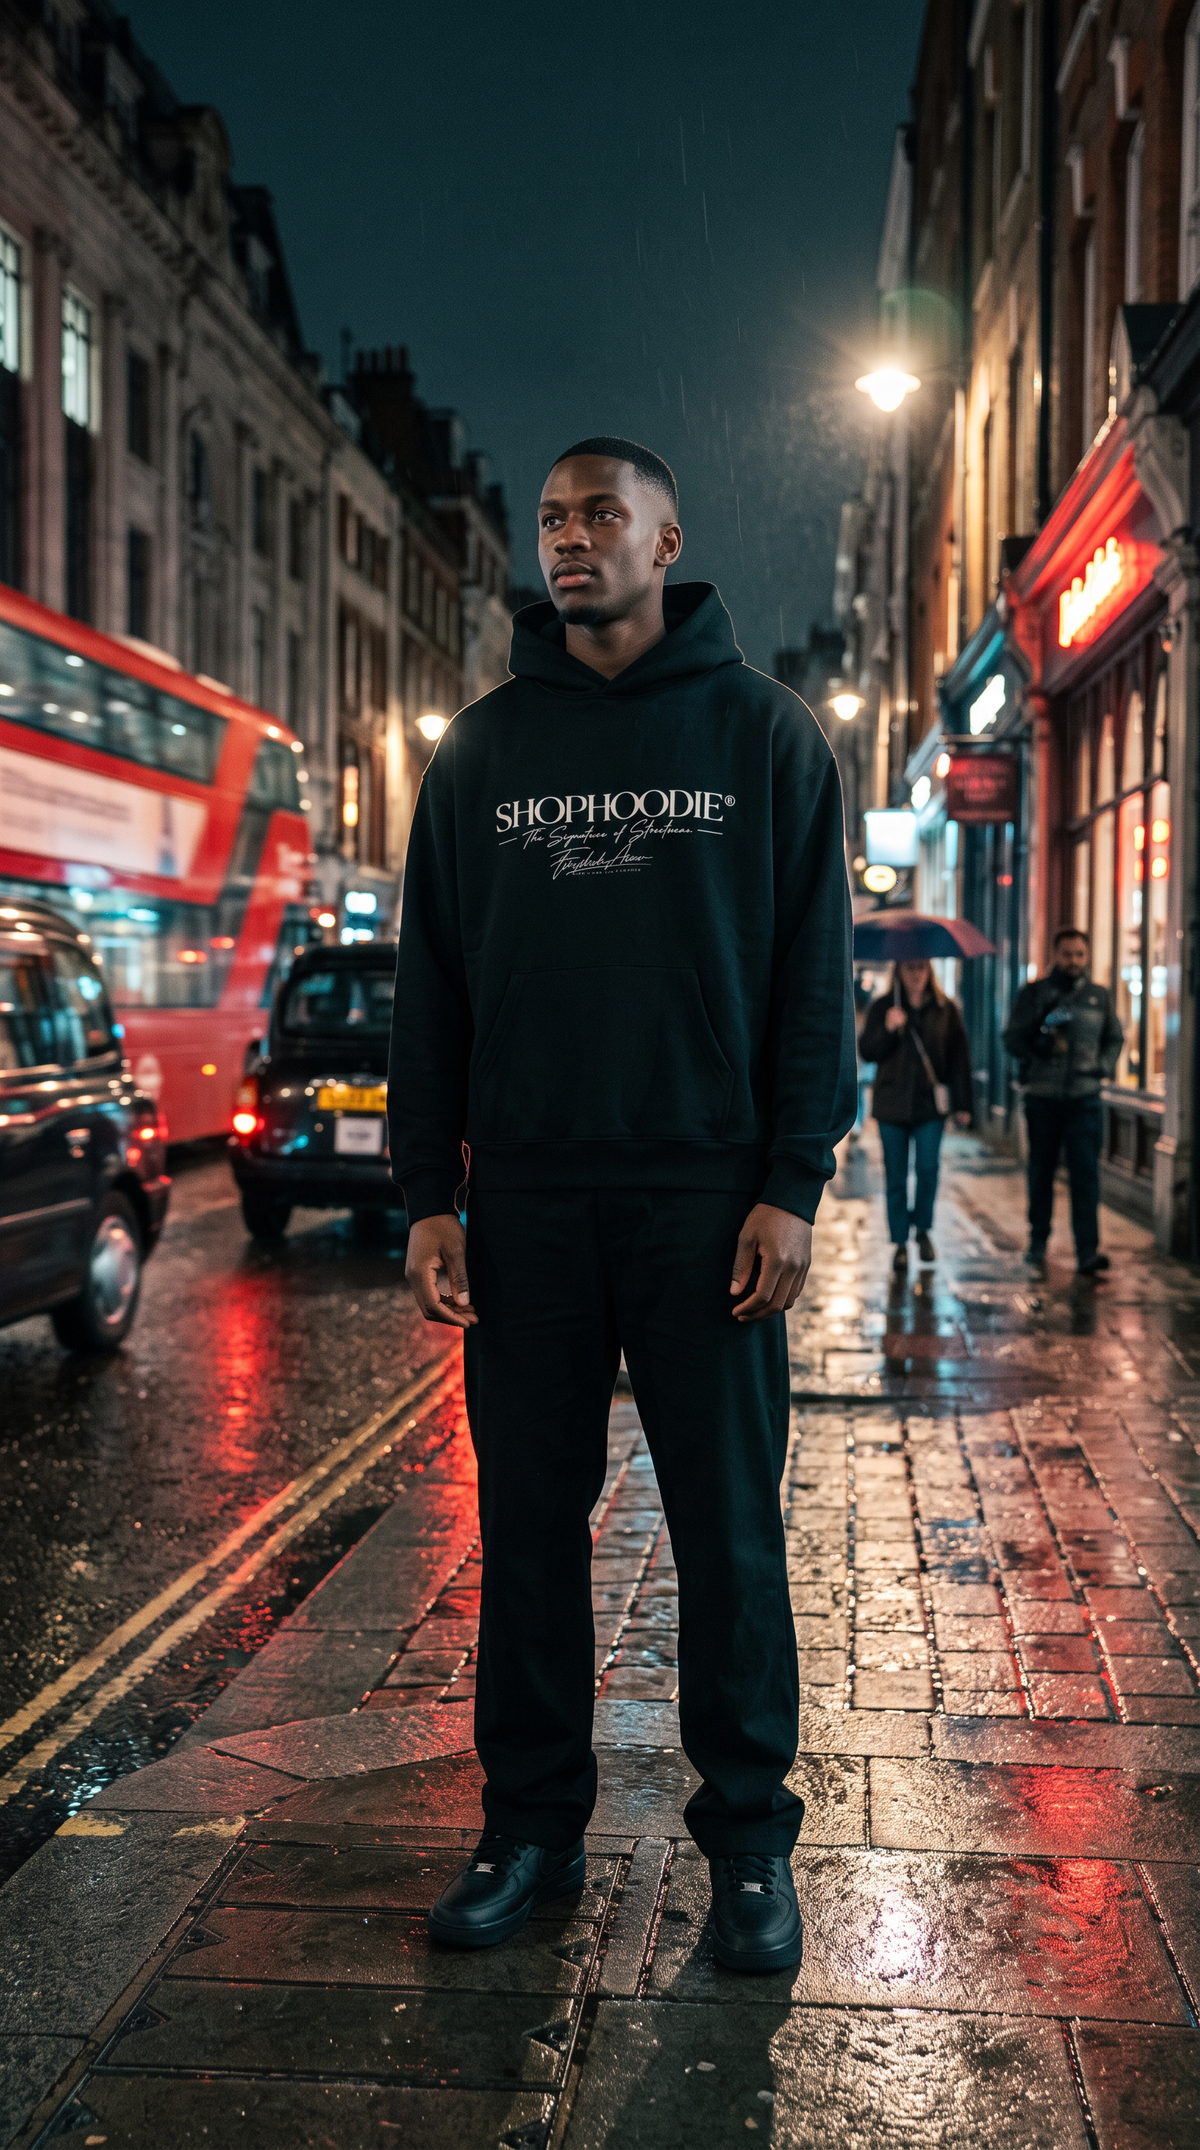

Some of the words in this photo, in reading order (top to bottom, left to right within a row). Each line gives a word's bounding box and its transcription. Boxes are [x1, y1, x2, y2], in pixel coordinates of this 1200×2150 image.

[522, 827, 547, 850] The
[546, 825, 608, 848] Signature
[613, 823, 628, 844] of
